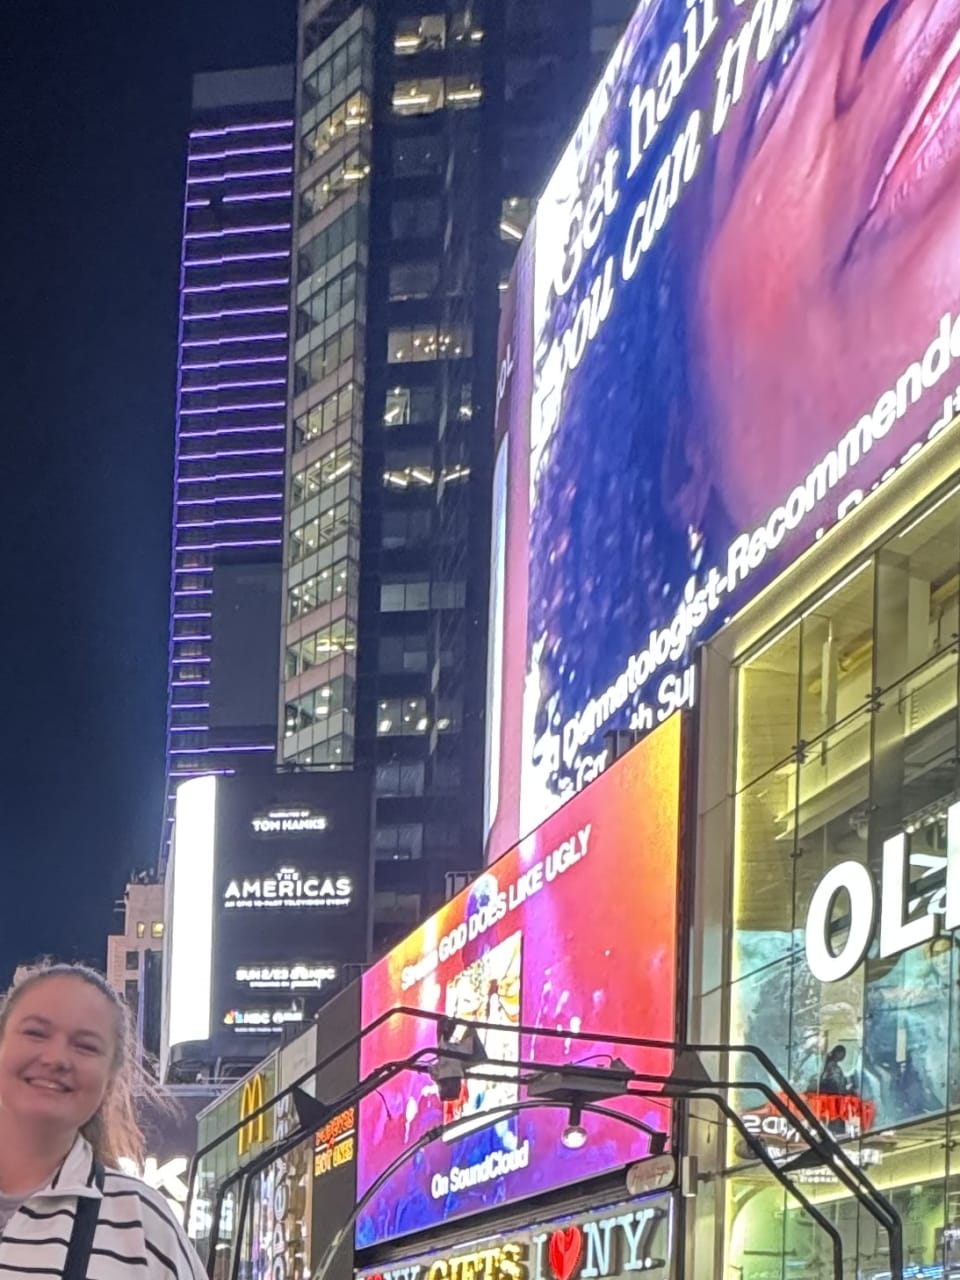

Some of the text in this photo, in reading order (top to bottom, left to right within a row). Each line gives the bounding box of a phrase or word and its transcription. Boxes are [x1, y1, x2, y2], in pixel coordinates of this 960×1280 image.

[623, 109, 701, 281] can
[252, 818, 326, 831] TOM HANKS
[224, 878, 351, 899] AMERICAS
[440, 922, 467, 963] GOD
[509, 862, 543, 911] LIKE
[545, 823, 591, 882] UGLY
[431, 1140, 529, 1199] On SoundCloud
